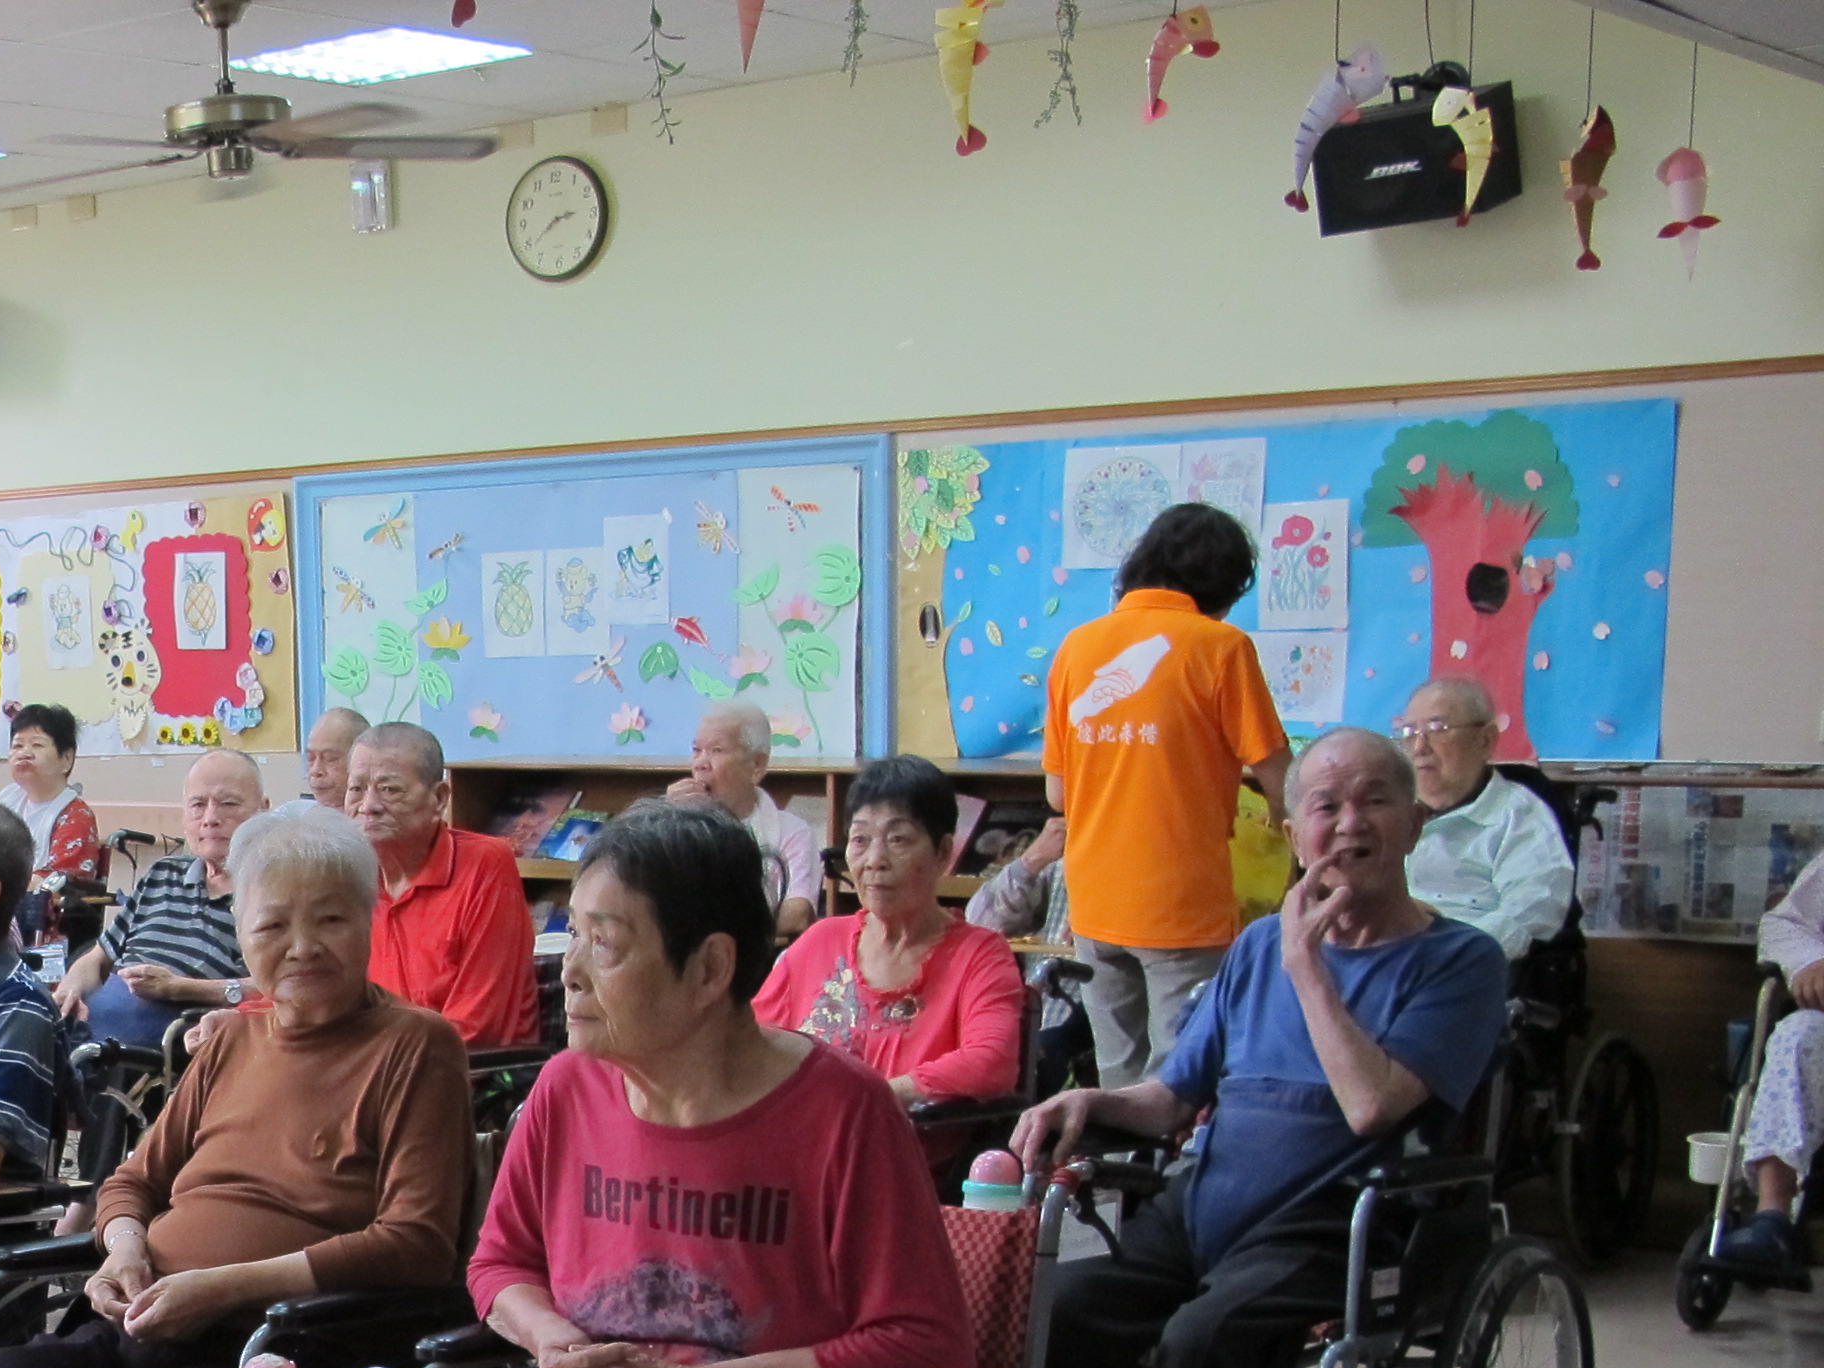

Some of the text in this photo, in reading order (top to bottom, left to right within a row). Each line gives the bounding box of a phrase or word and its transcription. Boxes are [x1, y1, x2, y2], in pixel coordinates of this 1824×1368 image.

[550, 170, 561, 183] 12
[534, 180, 542, 192] 11
[583, 185, 591, 199] 2
[522, 199, 534, 211] 10
[589, 206, 597, 219] 3
[519, 220, 527, 232] 9
[555, 257, 563, 269] 6
[584, 1164, 791, 1246] Bertinelli
